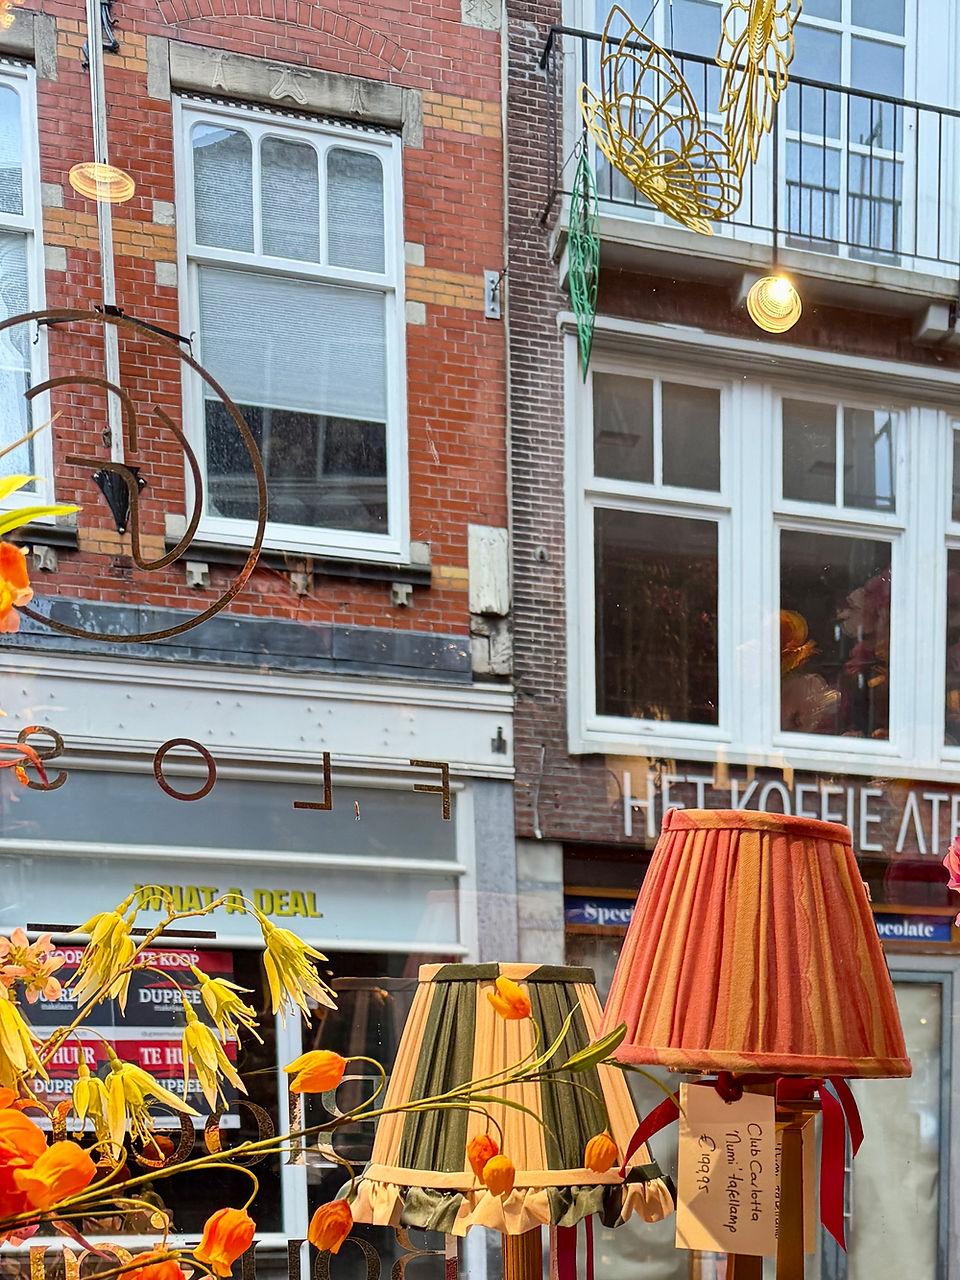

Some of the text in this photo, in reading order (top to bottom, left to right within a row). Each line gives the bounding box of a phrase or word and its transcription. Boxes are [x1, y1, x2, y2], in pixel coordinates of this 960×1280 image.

[133, 883, 323, 918] WHAT A DEAL
[160, 952, 200, 967] KOOP
[139, 1047, 163, 1066] TE
[747, 1122, 764, 1222] Club Carlotta
[722, 1173, 744, 1234] tafellamp
